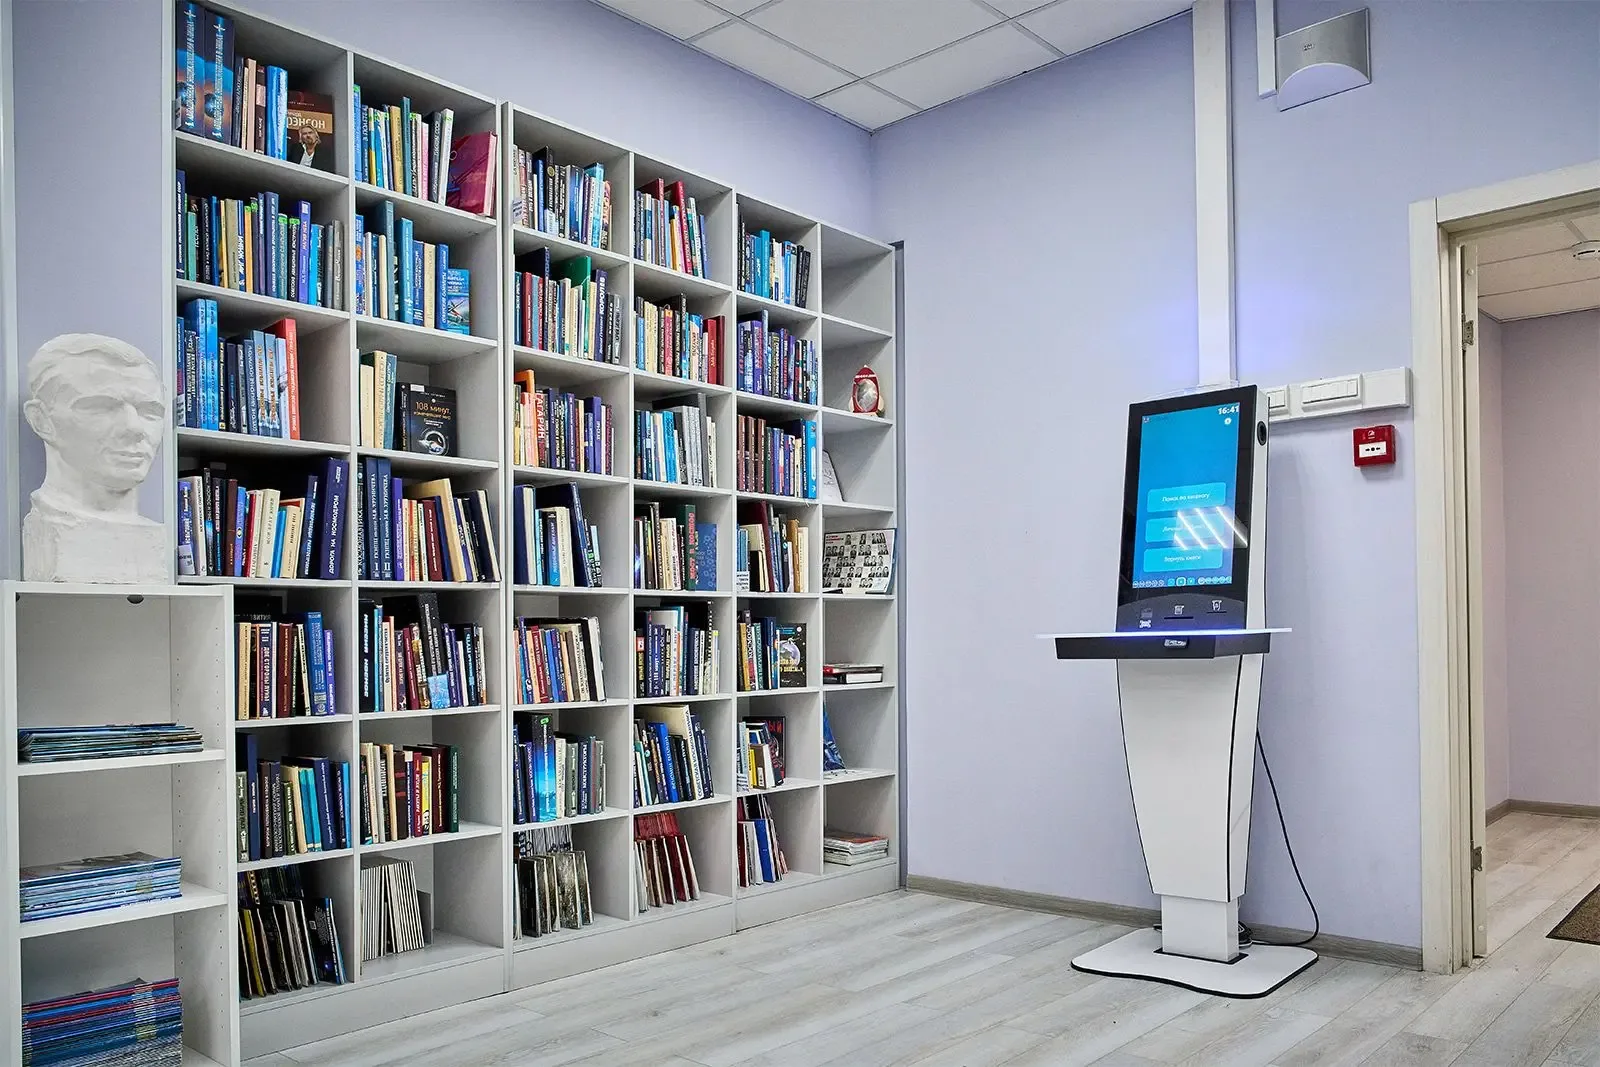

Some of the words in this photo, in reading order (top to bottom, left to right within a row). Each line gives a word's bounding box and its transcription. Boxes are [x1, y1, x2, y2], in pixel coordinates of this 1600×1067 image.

[286, 116, 326, 129] РЭНСОН
[416, 401, 429, 411] 108
[535, 393, 545, 439] ГАГАРИН
[1218, 406, 1239, 415] 16:41
[1162, 494, 1178, 502] Поиск
[330, 494, 339, 536] КОСМОДРОМ
[329, 538, 336, 548] НА
[262, 655, 270, 682] СТОРОНЫ
[262, 682, 270, 702] ЛУНЫ
[685, 710, 697, 763] КОСМОНАВТИКА
[692, 763, 702, 797] СОВЕТСКАЯ
